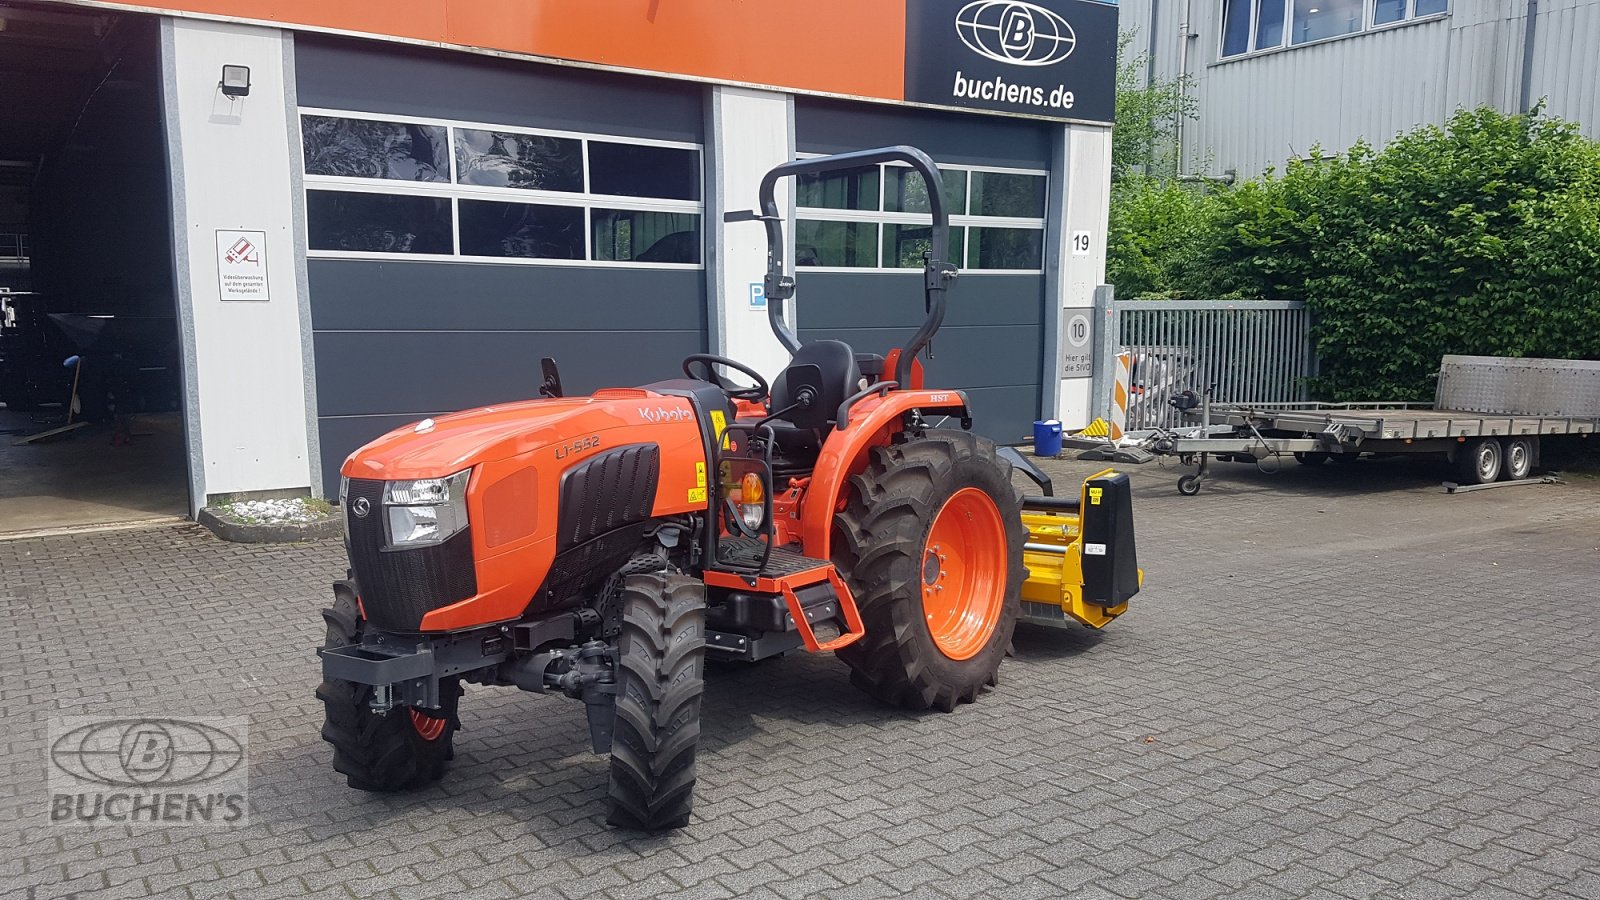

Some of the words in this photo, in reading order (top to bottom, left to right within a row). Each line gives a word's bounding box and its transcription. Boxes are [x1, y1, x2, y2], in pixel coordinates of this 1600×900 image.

[953, 71, 1075, 109] buchens.de
[1073, 234, 1090, 251] 19
[751, 284, 765, 304] P
[1073, 323, 1085, 338] 10
[1065, 353, 1079, 362] Hier
[1064, 363, 1075, 372] die
[929, 394, 949, 402] HST
[638, 406, 694, 422] Kubota
[554, 435, 600, 460] L1-552
